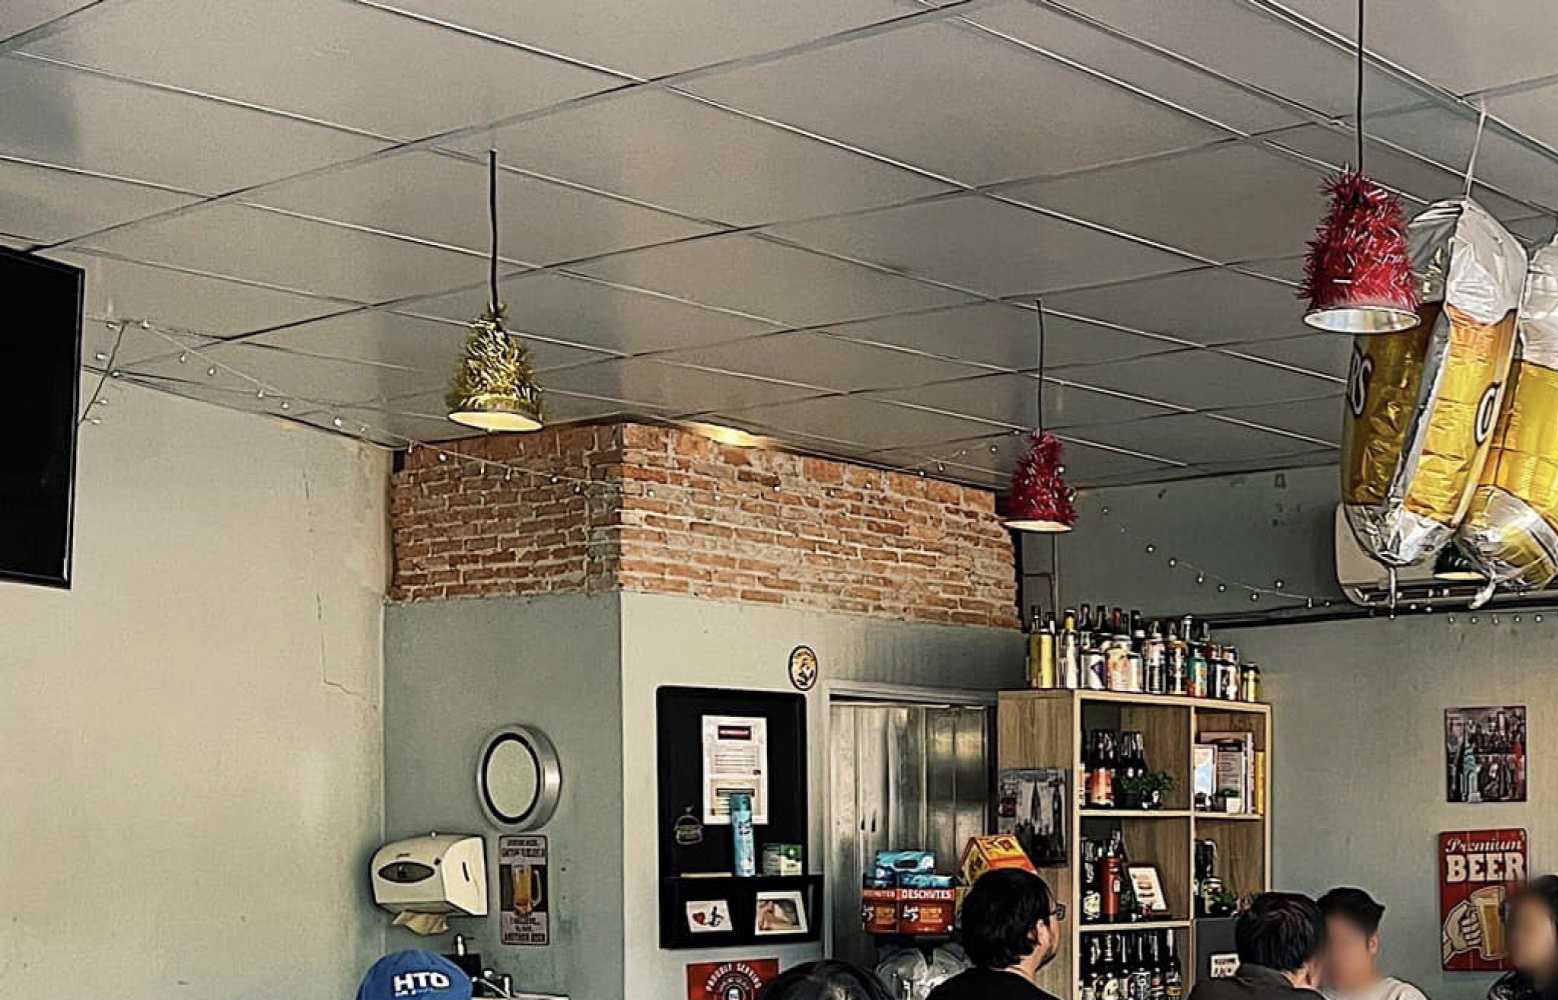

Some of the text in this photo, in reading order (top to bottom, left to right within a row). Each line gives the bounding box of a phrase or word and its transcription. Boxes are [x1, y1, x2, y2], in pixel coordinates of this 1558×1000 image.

[1445, 838, 1521, 853] Premium
[1446, 852, 1526, 882] BEER
[393, 971, 450, 992] HTO
